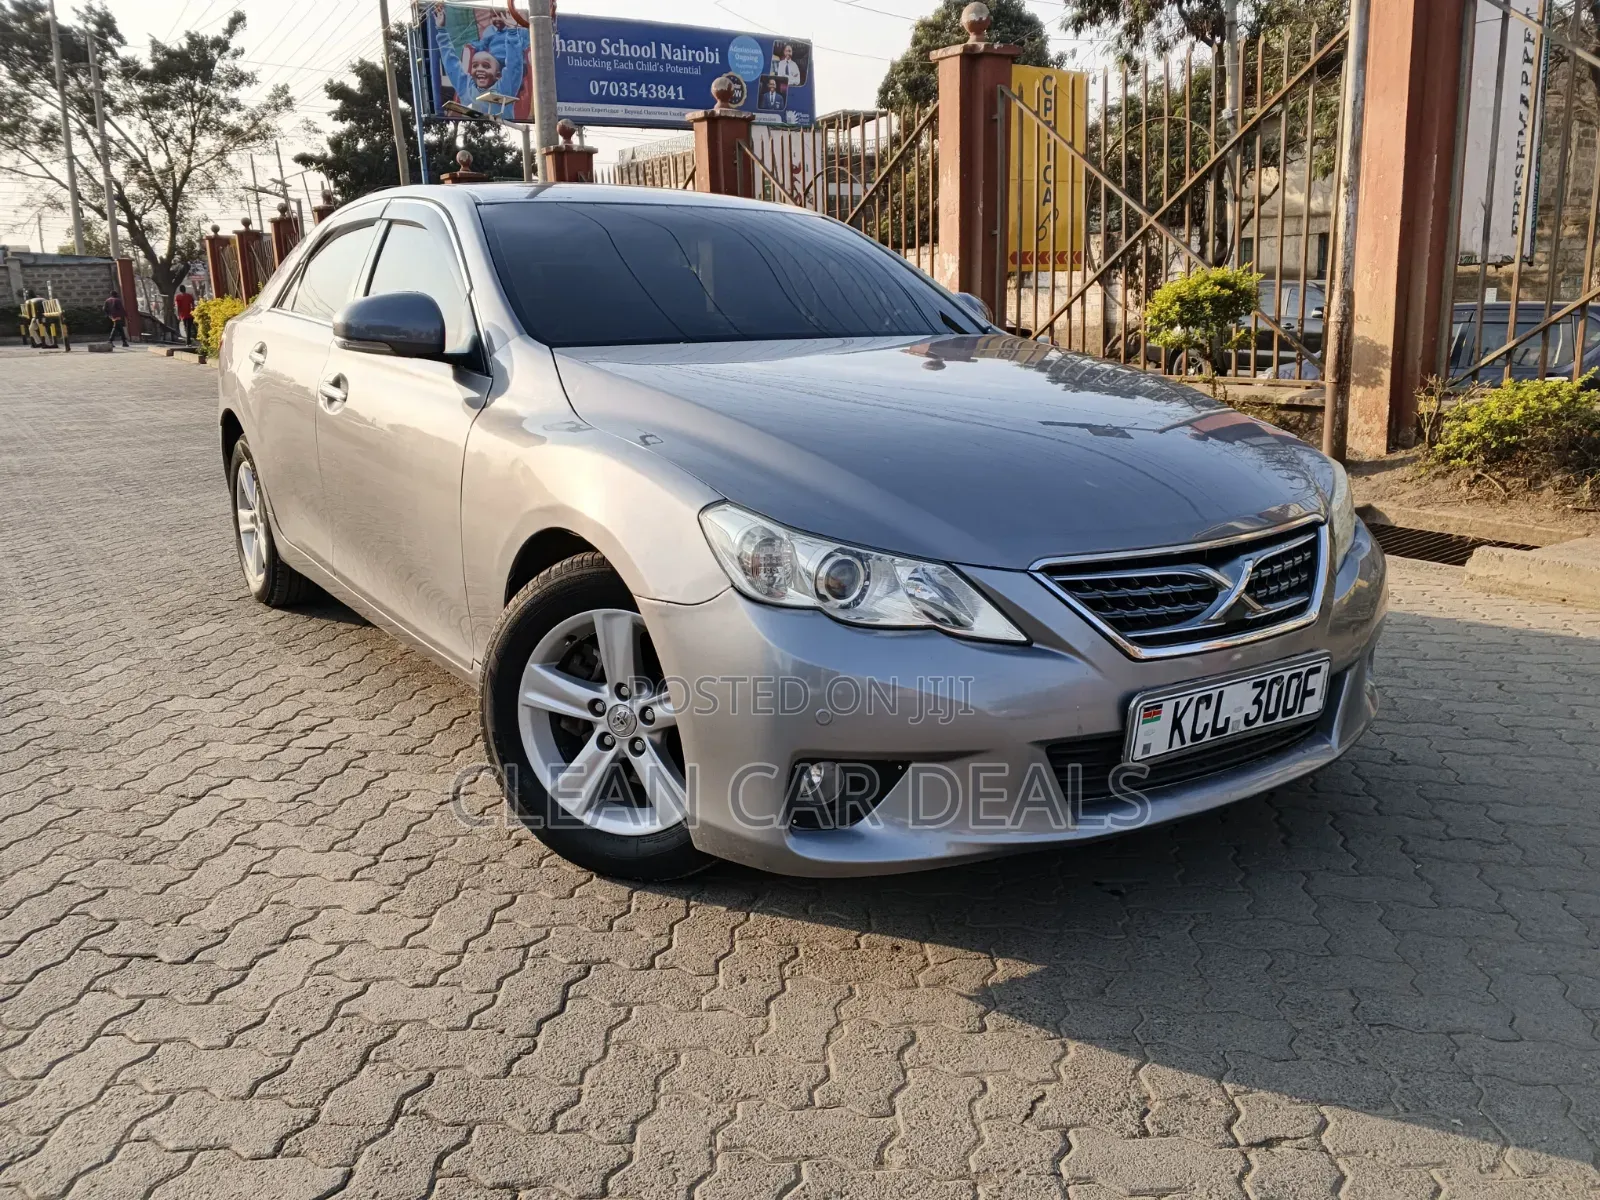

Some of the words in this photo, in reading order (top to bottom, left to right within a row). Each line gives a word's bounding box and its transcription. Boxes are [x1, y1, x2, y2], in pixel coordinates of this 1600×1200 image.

[555, 34, 597, 58] haro
[600, 38, 657, 59] School
[660, 42, 720, 65] Nairobi
[735, 53, 758, 63] Ongoing
[567, 56, 612, 71] Unlocking
[613, 59, 634, 70] Each
[635, 61, 664, 73] Child's
[665, 64, 702, 76] Potential
[589, 80, 686, 101] 0703543841
[564, 105, 591, 113] Education
[591, 106, 620, 115] Experience
[1168, 690, 1231, 750] KCL
[1244, 665, 1322, 727] 300F
